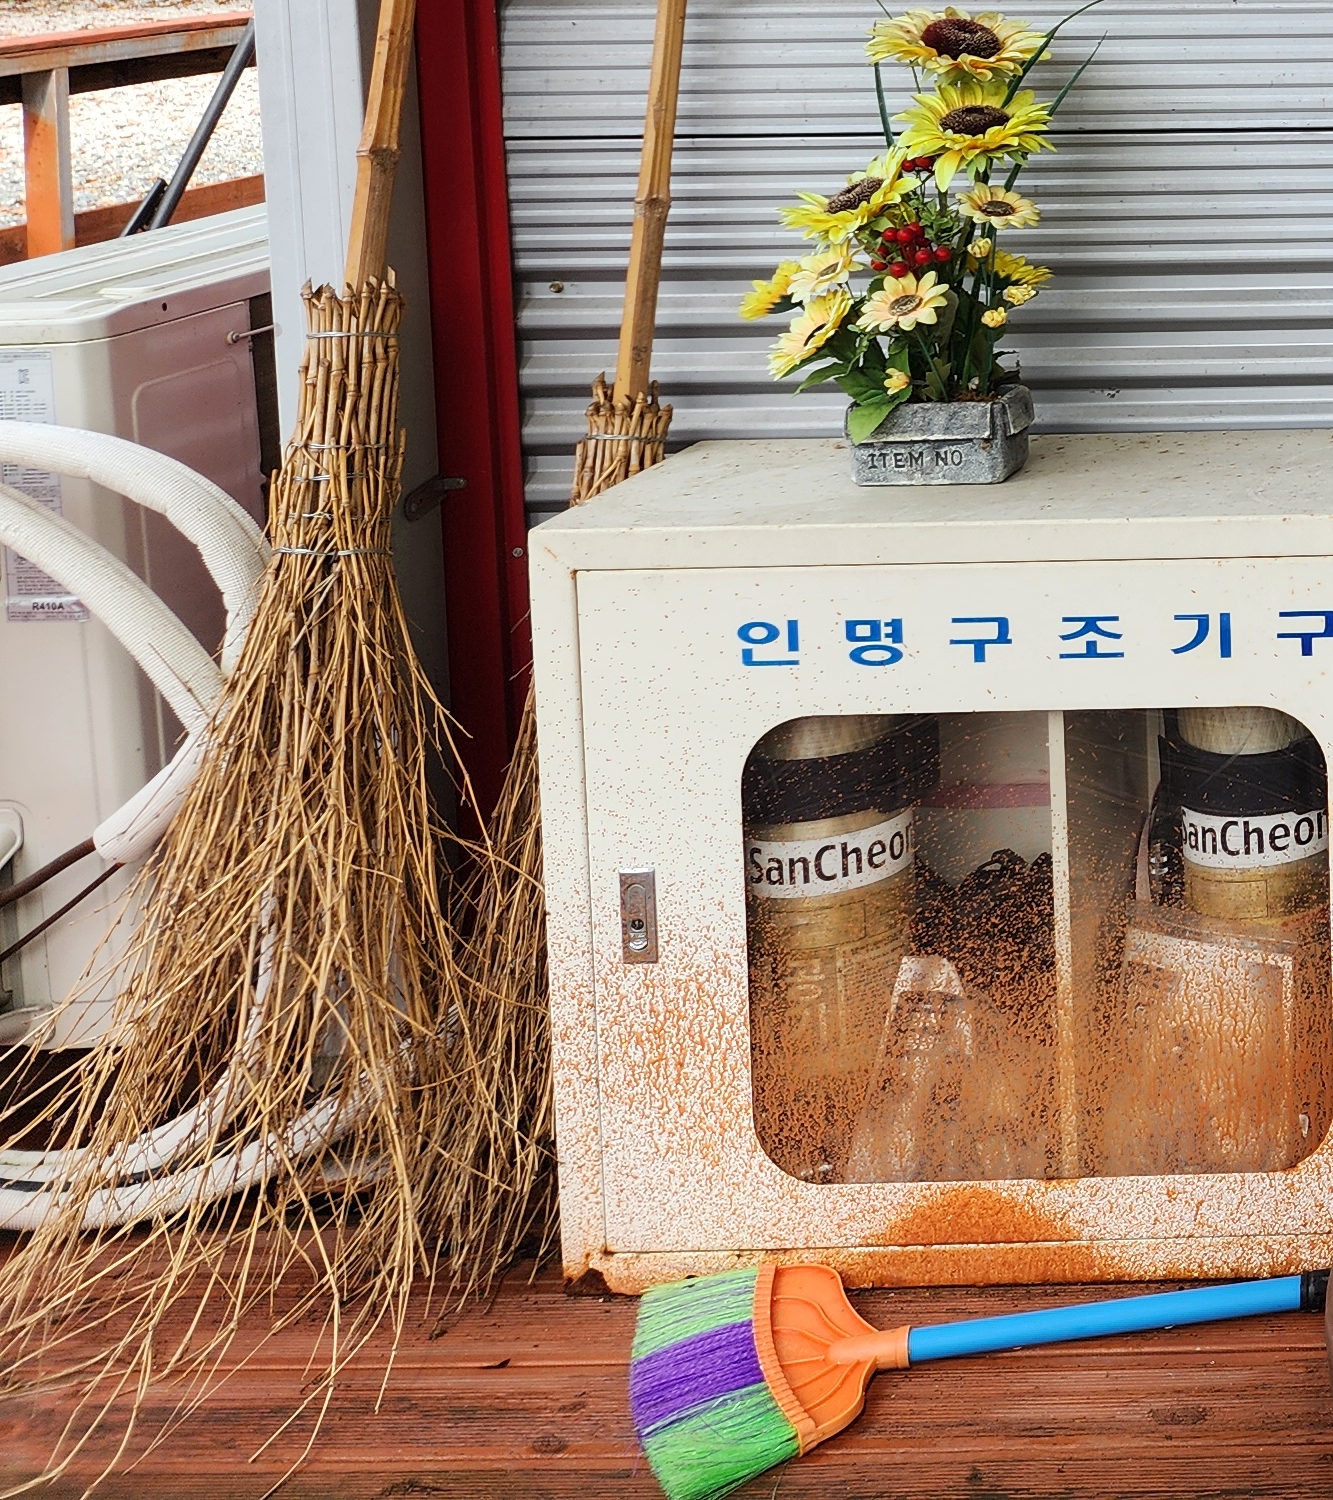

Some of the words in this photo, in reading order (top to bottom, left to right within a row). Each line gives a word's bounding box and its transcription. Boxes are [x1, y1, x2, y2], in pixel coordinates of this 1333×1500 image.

[867, 450, 924, 470] ITEM
[934, 448, 963, 467] NO
[31, 601, 65, 612] R410A
